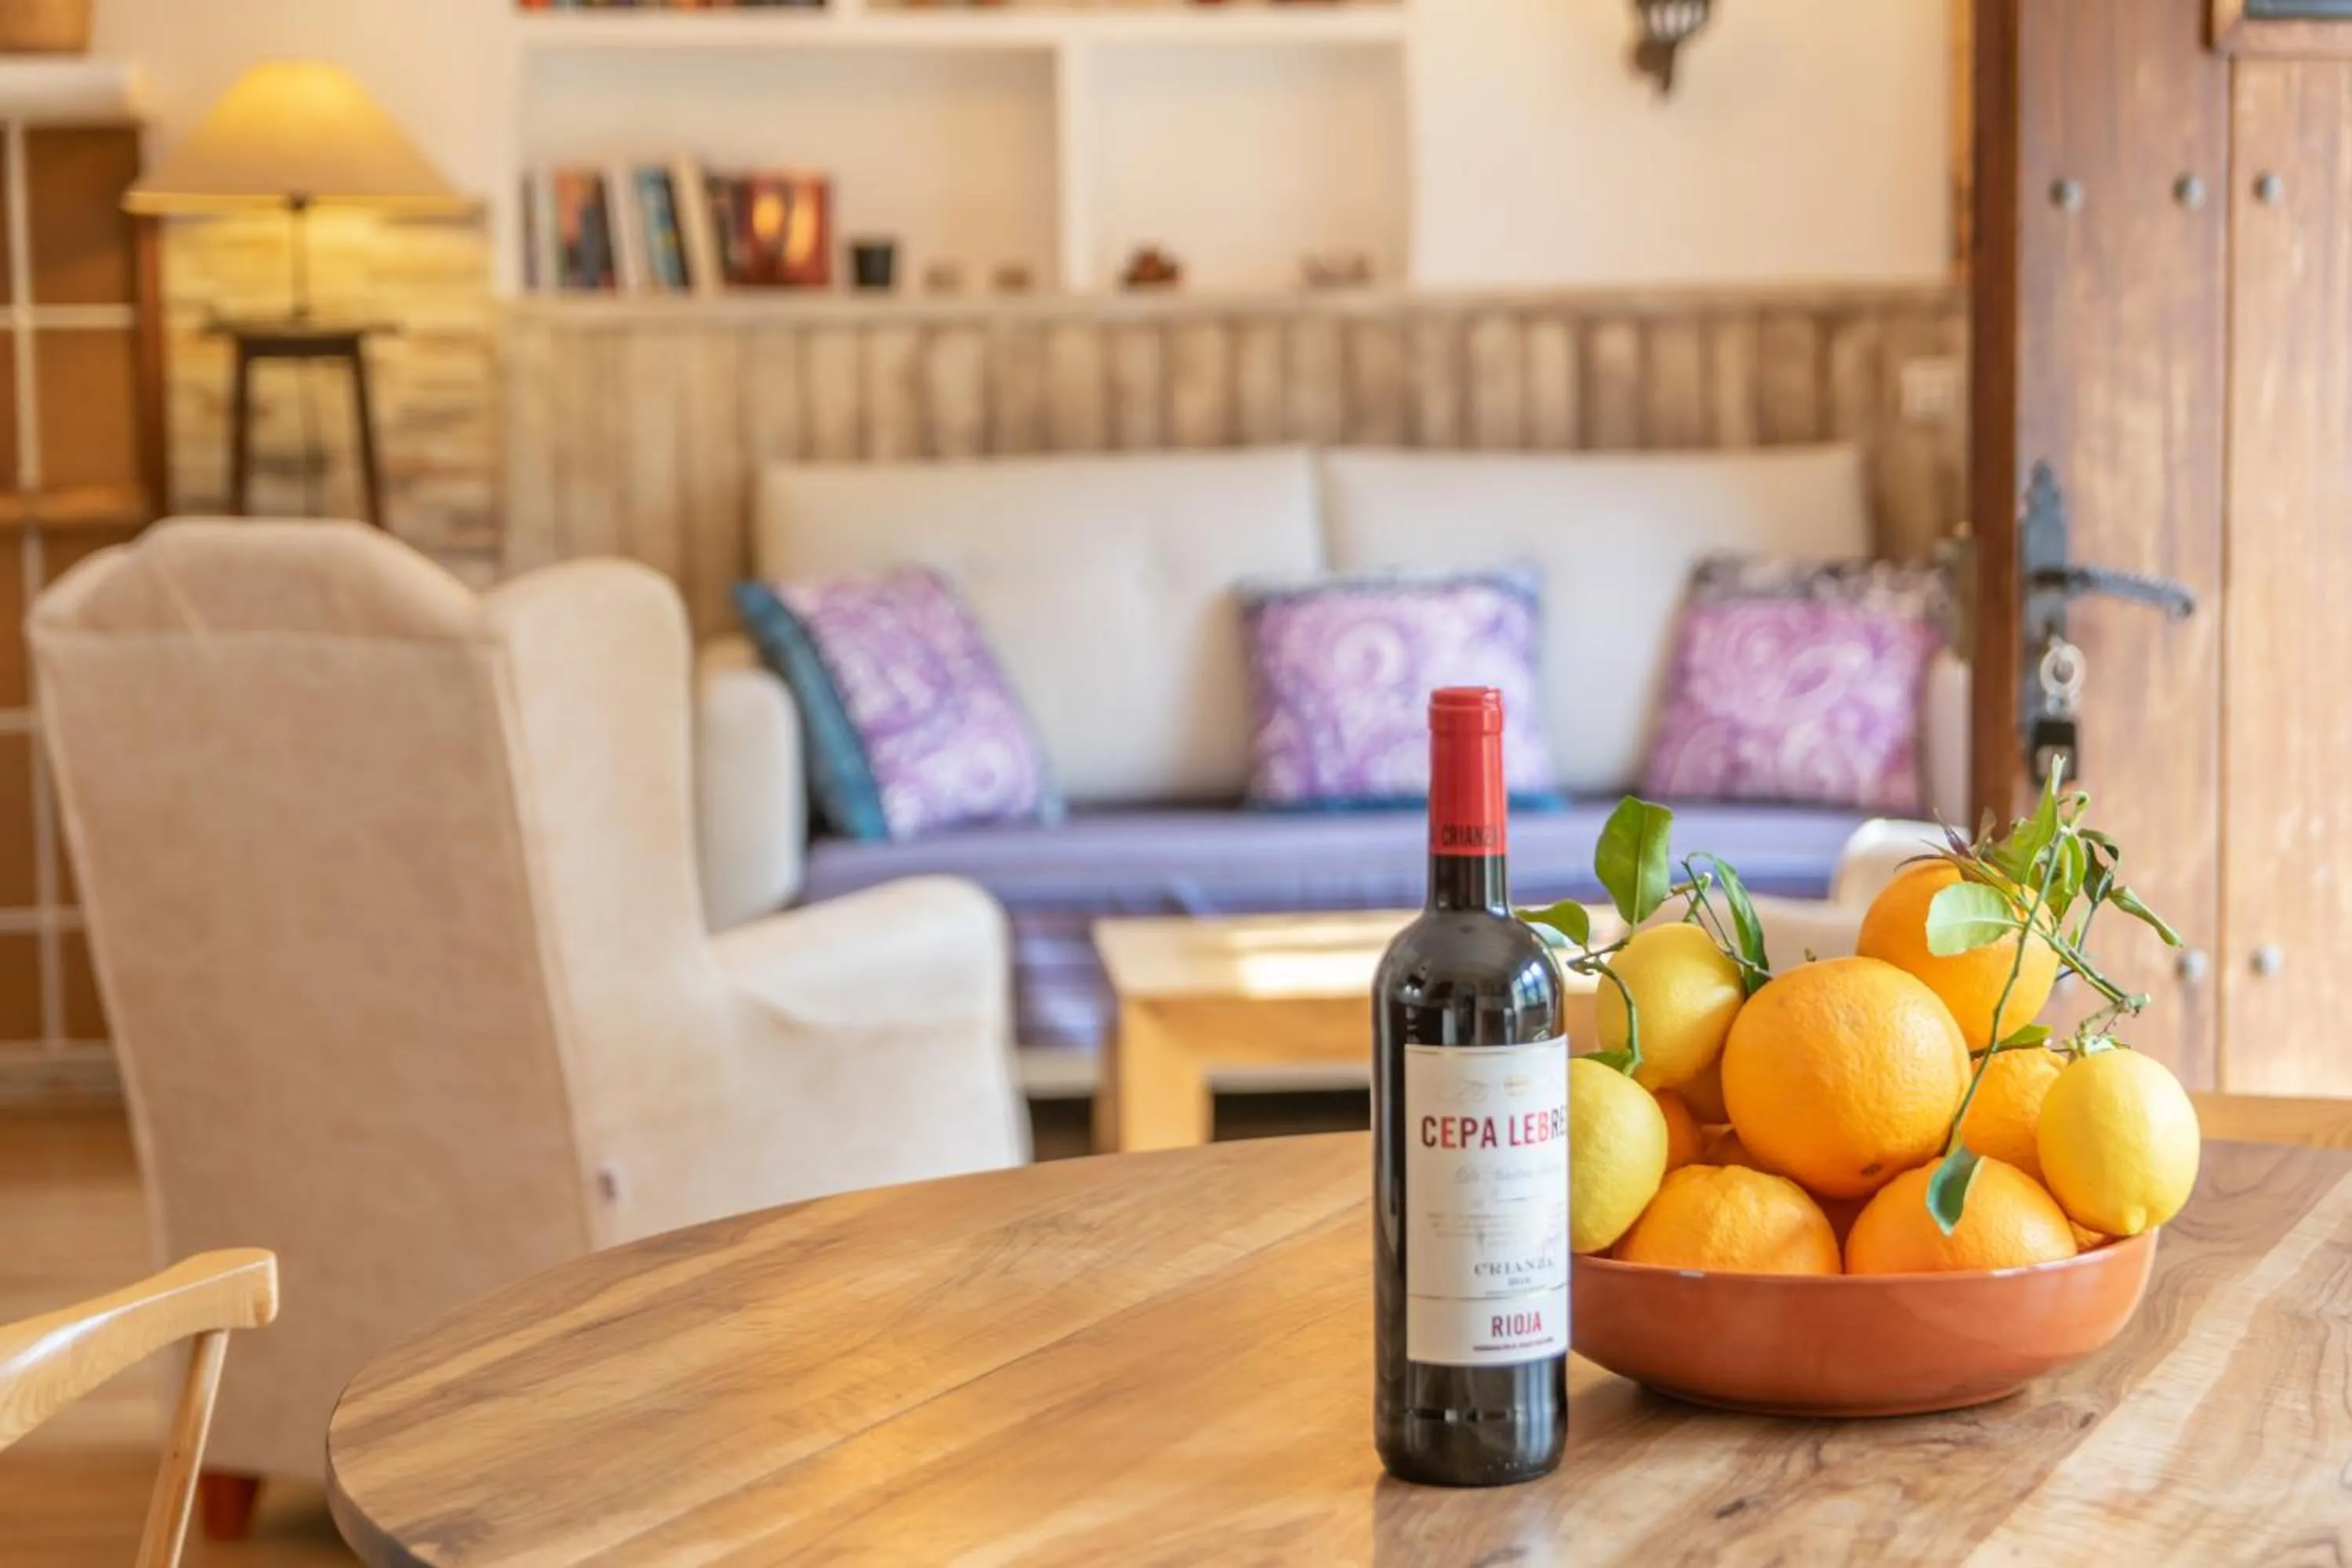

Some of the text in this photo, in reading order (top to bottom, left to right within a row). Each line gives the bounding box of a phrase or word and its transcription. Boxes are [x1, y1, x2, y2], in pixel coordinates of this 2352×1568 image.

[1421, 1114, 1497, 1149] CEPA
[1473, 1256, 1555, 1277] CRIANZA
[1491, 1310, 1542, 1339] RIOJA
